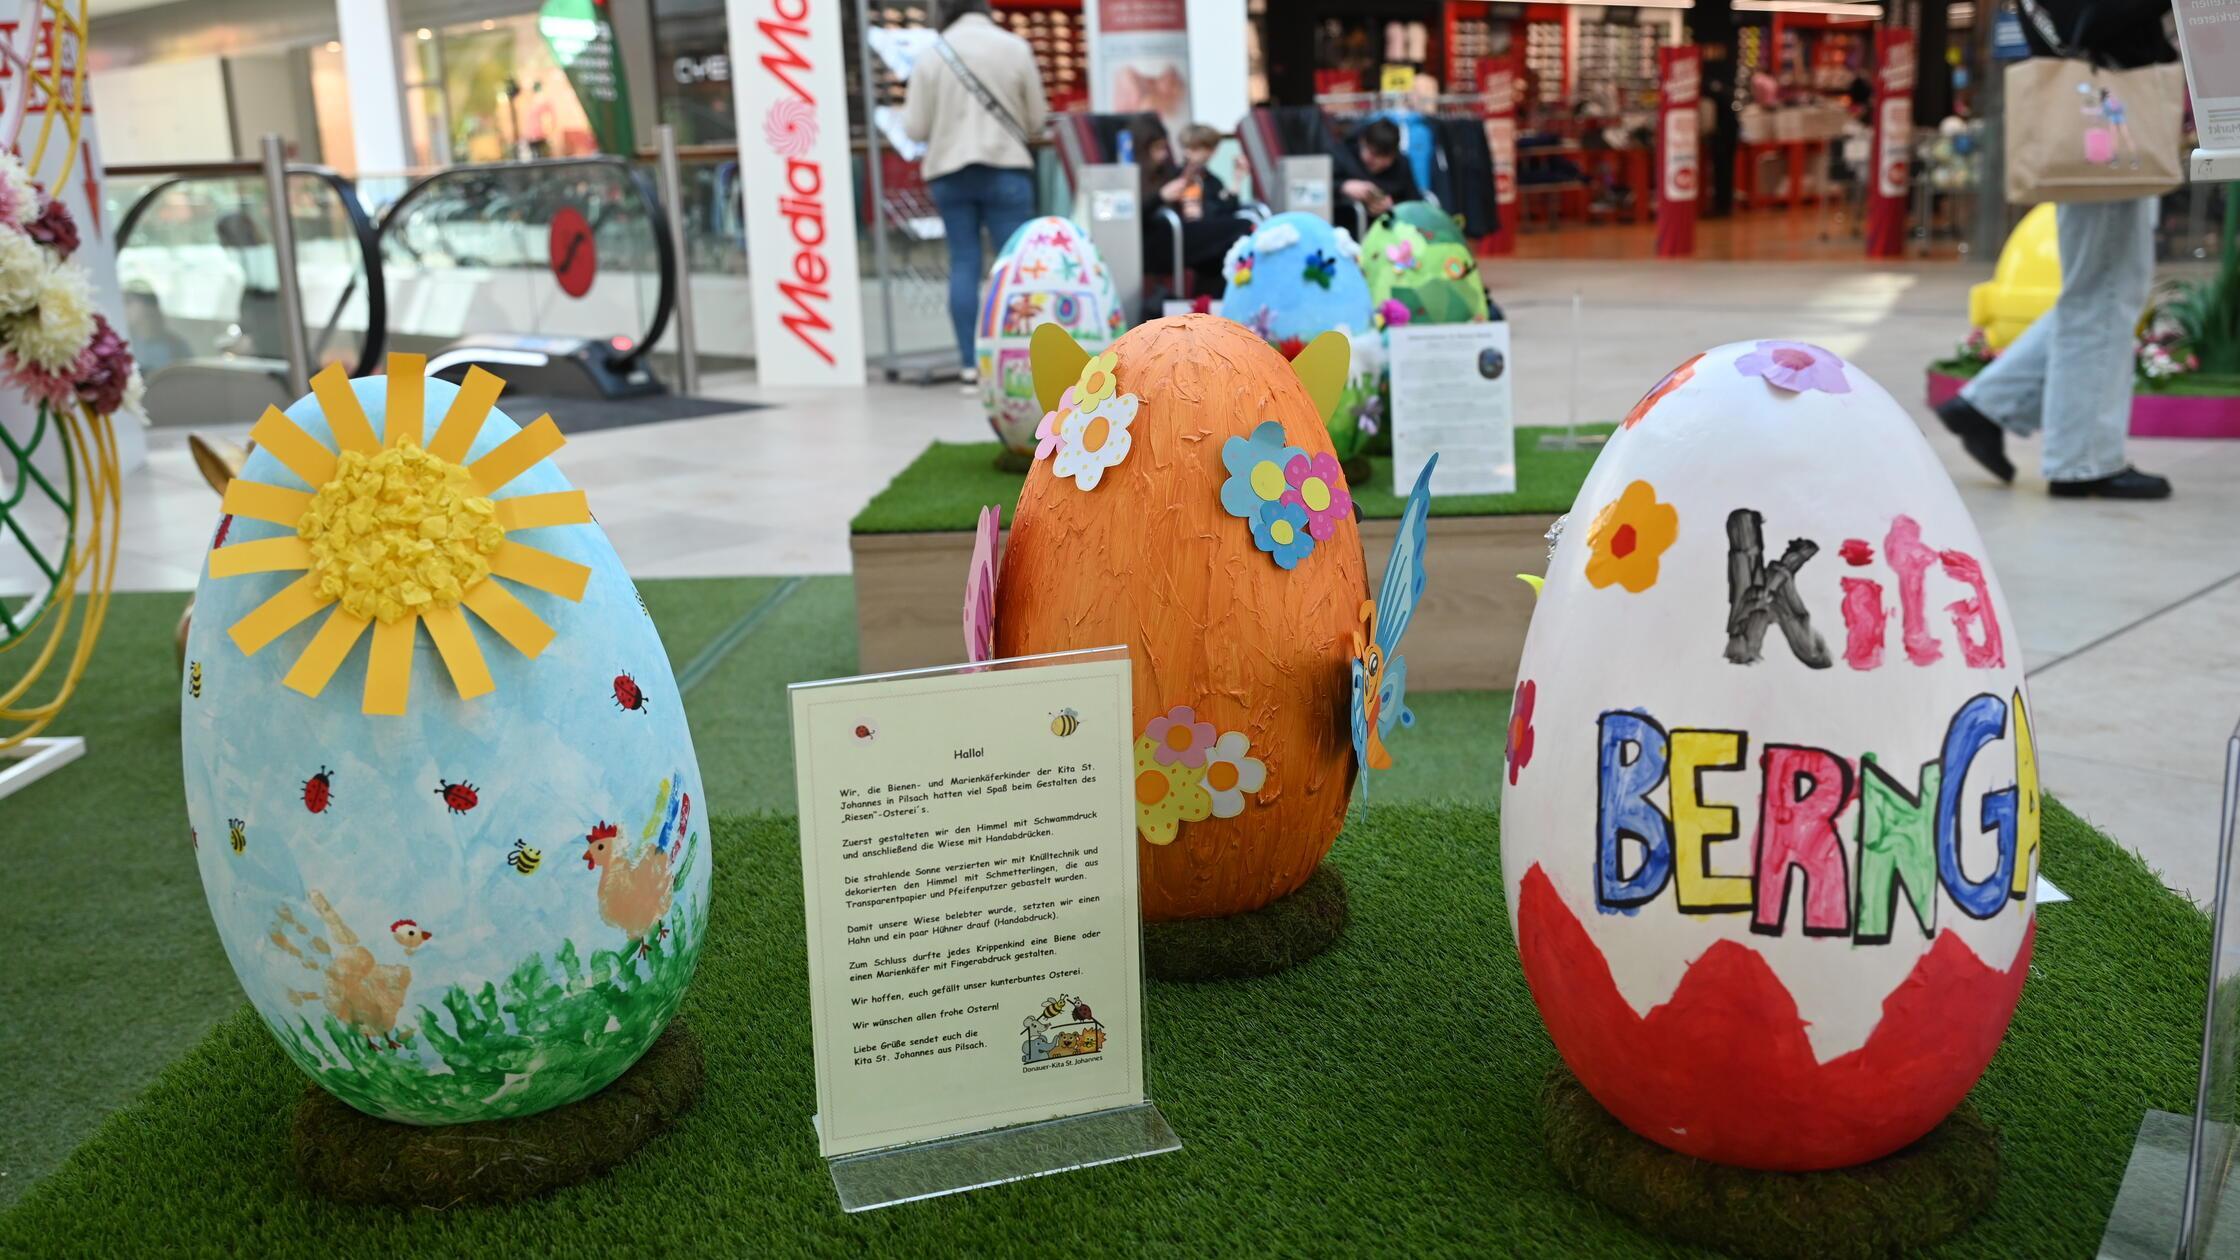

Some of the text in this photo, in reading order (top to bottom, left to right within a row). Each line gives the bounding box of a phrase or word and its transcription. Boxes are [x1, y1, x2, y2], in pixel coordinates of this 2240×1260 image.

[1723, 507, 2005, 670] Kita
[954, 747, 984, 759] Hallo!
[840, 800, 882, 810] Johannes
[899, 793, 928, 803] Pilsach
[933, 791, 963, 799] hatten
[967, 787, 982, 796] viel
[986, 784, 1008, 795] Spaß
[1012, 783, 1032, 791] beim
[1036, 778, 1078, 788] Gestalten
[1081, 775, 1097, 783] des
[868, 786, 881, 794] die
[887, 784, 921, 792] Bienen-
[928, 778, 944, 787] und
[950, 770, 1030, 785] Marienkäferkinder
[1037, 768, 1052, 776] der
[1058, 766, 1075, 774] Kita
[842, 811, 1097, 847] Zuerst gestalteten wir den Himmel mit Schwammdruck
[842, 829, 1054, 859] und anschließend die Wiese mit Handabdrücken.
[844, 846, 1098, 884] Die strahlende Sonne verzierten wir mit Knülltechnik und
[845, 885, 897, 896] dekorierten
[903, 881, 920, 889] den
[926, 875, 958, 887] Himmel
[964, 873, 979, 882] mit
[846, 873, 1087, 908] Transparentpapier und Pfeifenputzer gebastelt wurden.
[847, 923, 873, 933] Damit
[878, 921, 908, 929] unsere
[913, 916, 940, 925] Wiese
[945, 910, 983, 920] belebter
[1022, 902, 1055, 912] setzten
[1060, 898, 1074, 906] wir
[847, 936, 871, 945] Hahn
[873, 933, 890, 942] und
[893, 932, 906, 940] ein
[909, 930, 929, 940] paar
[932, 925, 963, 934] Hühner
[966, 919, 990, 929] drauf
[874, 957, 907, 966] Schluss
[912, 952, 941, 961] durfte
[947, 947, 971, 959] jedes
[976, 939, 1025, 953] Krippenkind
[1082, 930, 1101, 939] oder
[849, 949, 1057, 981] einen Marienkäfer mit Fingerabdruck gestalten.
[851, 997, 869, 1005] Wir
[908, 989, 929, 998] euch
[931, 984, 960, 997] gefällt
[963, 982, 987, 990] unser
[990, 974, 1046, 987] kunterbuntes
[1049, 968, 1084, 979] Osterei.
[852, 1002, 1000, 1030] Wir wünschen allen frohe Ostern!
[853, 1030, 978, 1054] Liebe Grüße sendet euch die
[854, 1057, 873, 1066] Kita
[875, 1054, 890, 1062] St.
[894, 1049, 935, 1060] Johannes
[955, 1041, 988, 1051] Pilsach.
[1022, 1056, 1103, 1073] Donauer-Kita St. Johannes
